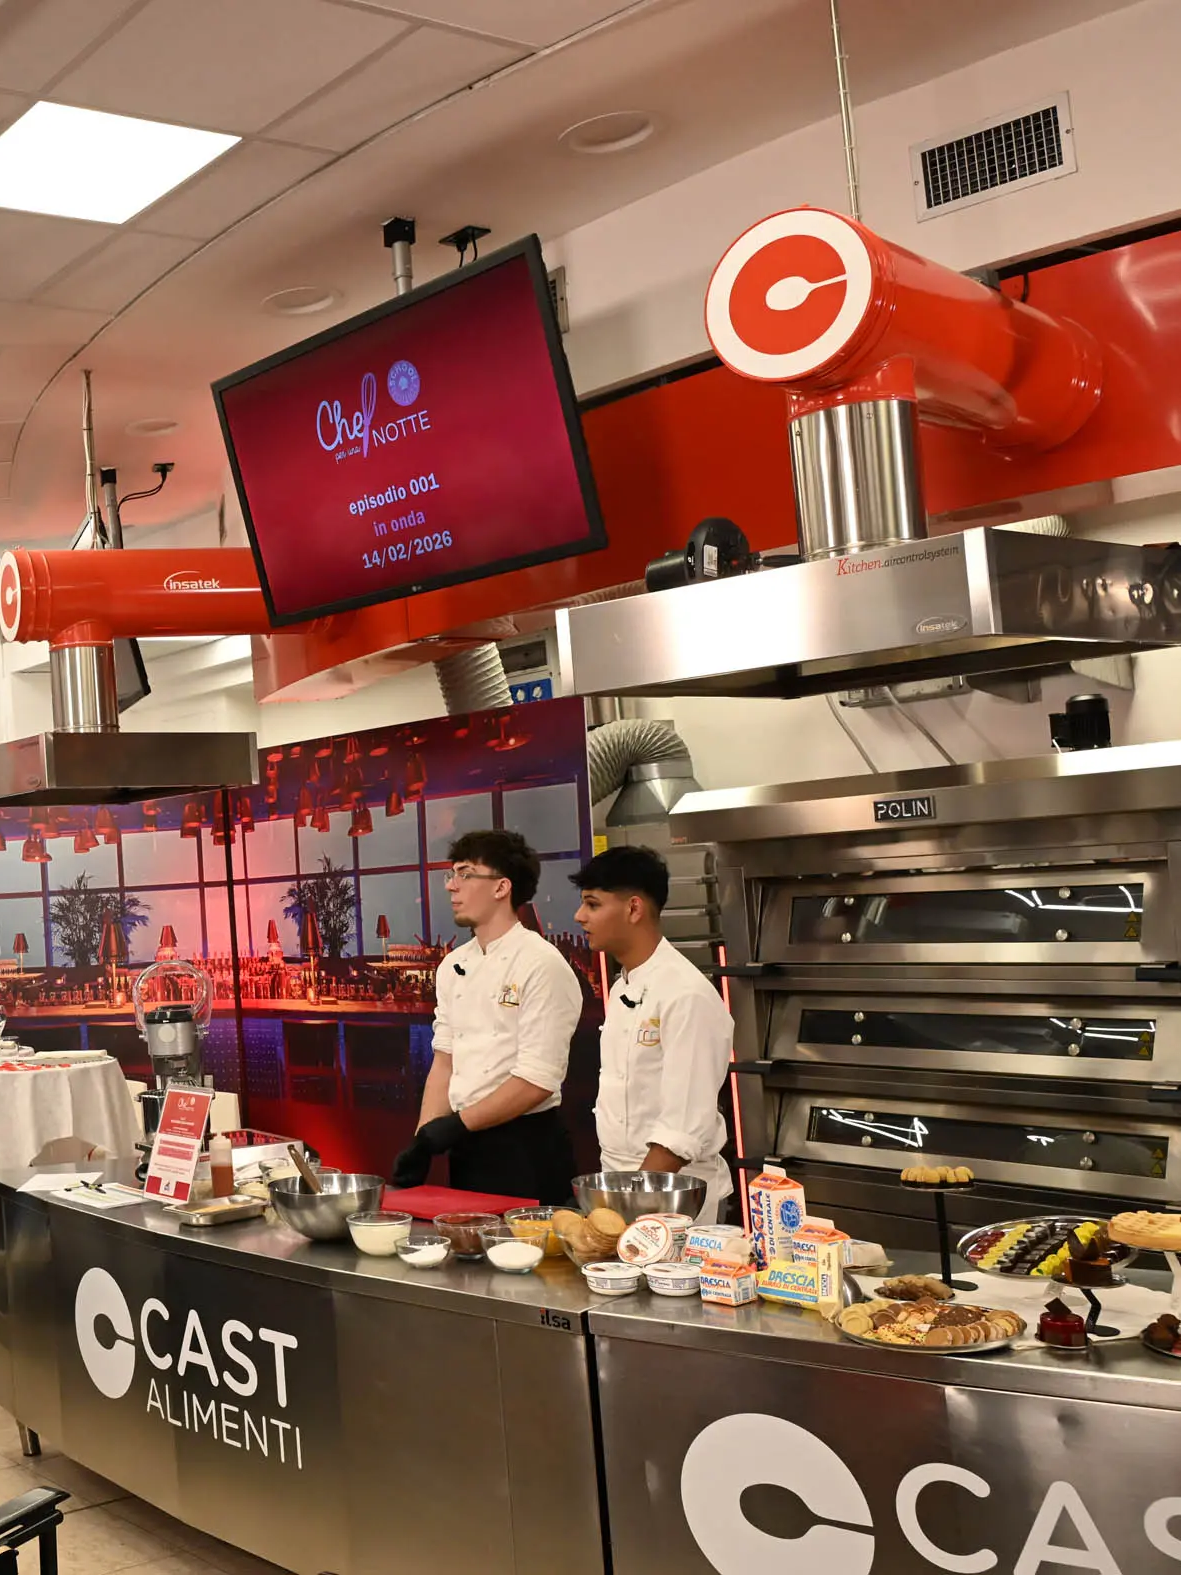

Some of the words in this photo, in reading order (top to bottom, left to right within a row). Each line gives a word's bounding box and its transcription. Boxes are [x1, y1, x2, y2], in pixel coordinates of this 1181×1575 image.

[317, 372, 376, 458] Chef
[372, 410, 431, 447] NOTTE
[349, 485, 407, 516] episodio
[409, 473, 440, 495] 001
[373, 521, 387, 537] in
[391, 510, 426, 531] onda
[362, 530, 453, 569] 14/02/2026
[169, 577, 220, 591] insatek
[877, 799, 929, 819] POLIN
[540, 1307, 571, 1330] ilsa
[140, 1297, 299, 1408] CAST
[146, 1377, 303, 1470] ALIMENTI
